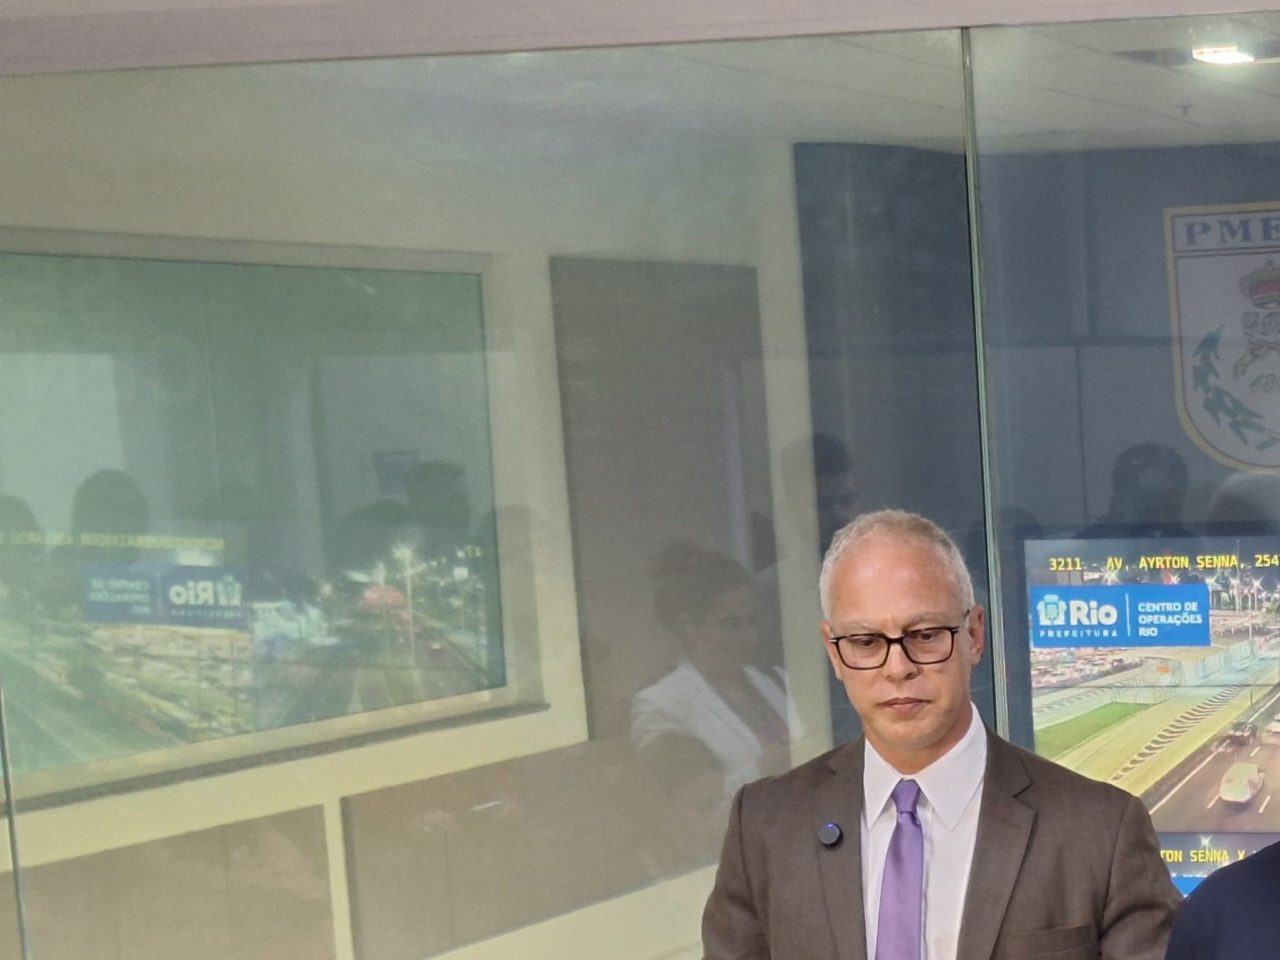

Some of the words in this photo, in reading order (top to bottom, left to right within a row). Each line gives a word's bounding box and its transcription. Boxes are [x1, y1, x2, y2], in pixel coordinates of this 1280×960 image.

[1049, 557, 1082, 571] 3211
[1138, 555, 1190, 570] AYRTON
[1069, 600, 1118, 625] Rio
[1137, 601, 1183, 613] CENTRO
[1184, 601, 1198, 612] DE
[1138, 612, 1203, 627] OPERAÇÕES
[1039, 629, 1118, 638] PREFEITURA
[1138, 627, 1158, 637] RIO
[1189, 849, 1230, 864] SENNA
